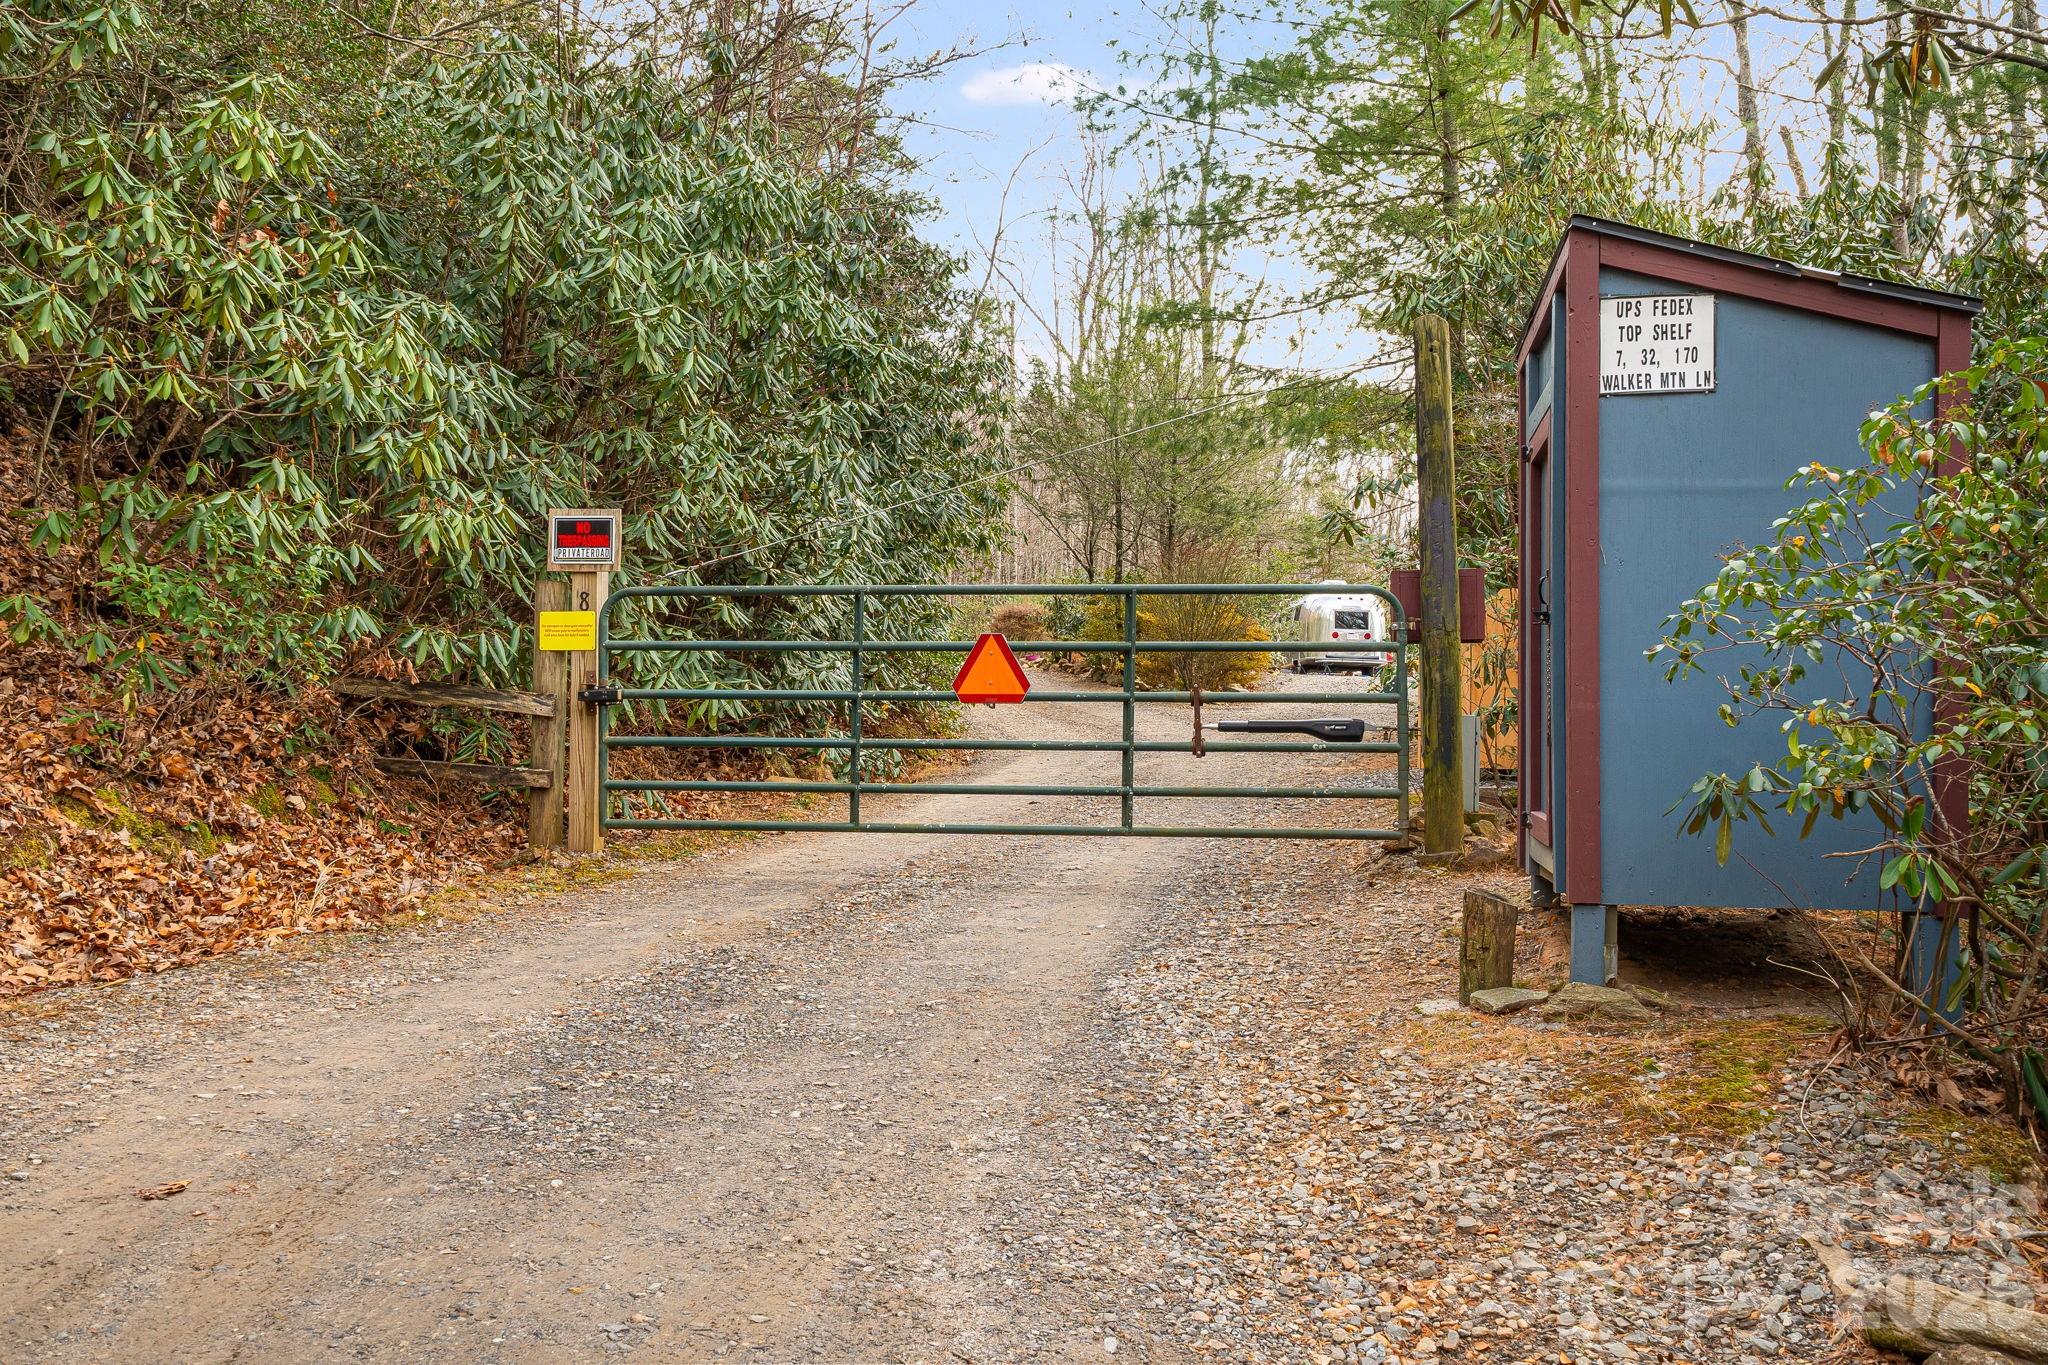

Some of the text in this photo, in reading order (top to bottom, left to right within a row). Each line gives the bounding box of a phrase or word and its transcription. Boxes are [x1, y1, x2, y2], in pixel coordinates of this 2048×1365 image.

[1616, 298, 1693, 318] UPS FEDEX
[1618, 323, 1692, 342] TOP SHELF
[1616, 346, 1698, 369] 7, 32, 170
[1602, 370, 1711, 391] WALKER MTN LN
[576, 521, 591, 534] NO
[557, 534, 609, 547] TRESPASSING
[580, 591, 590, 611] 8
